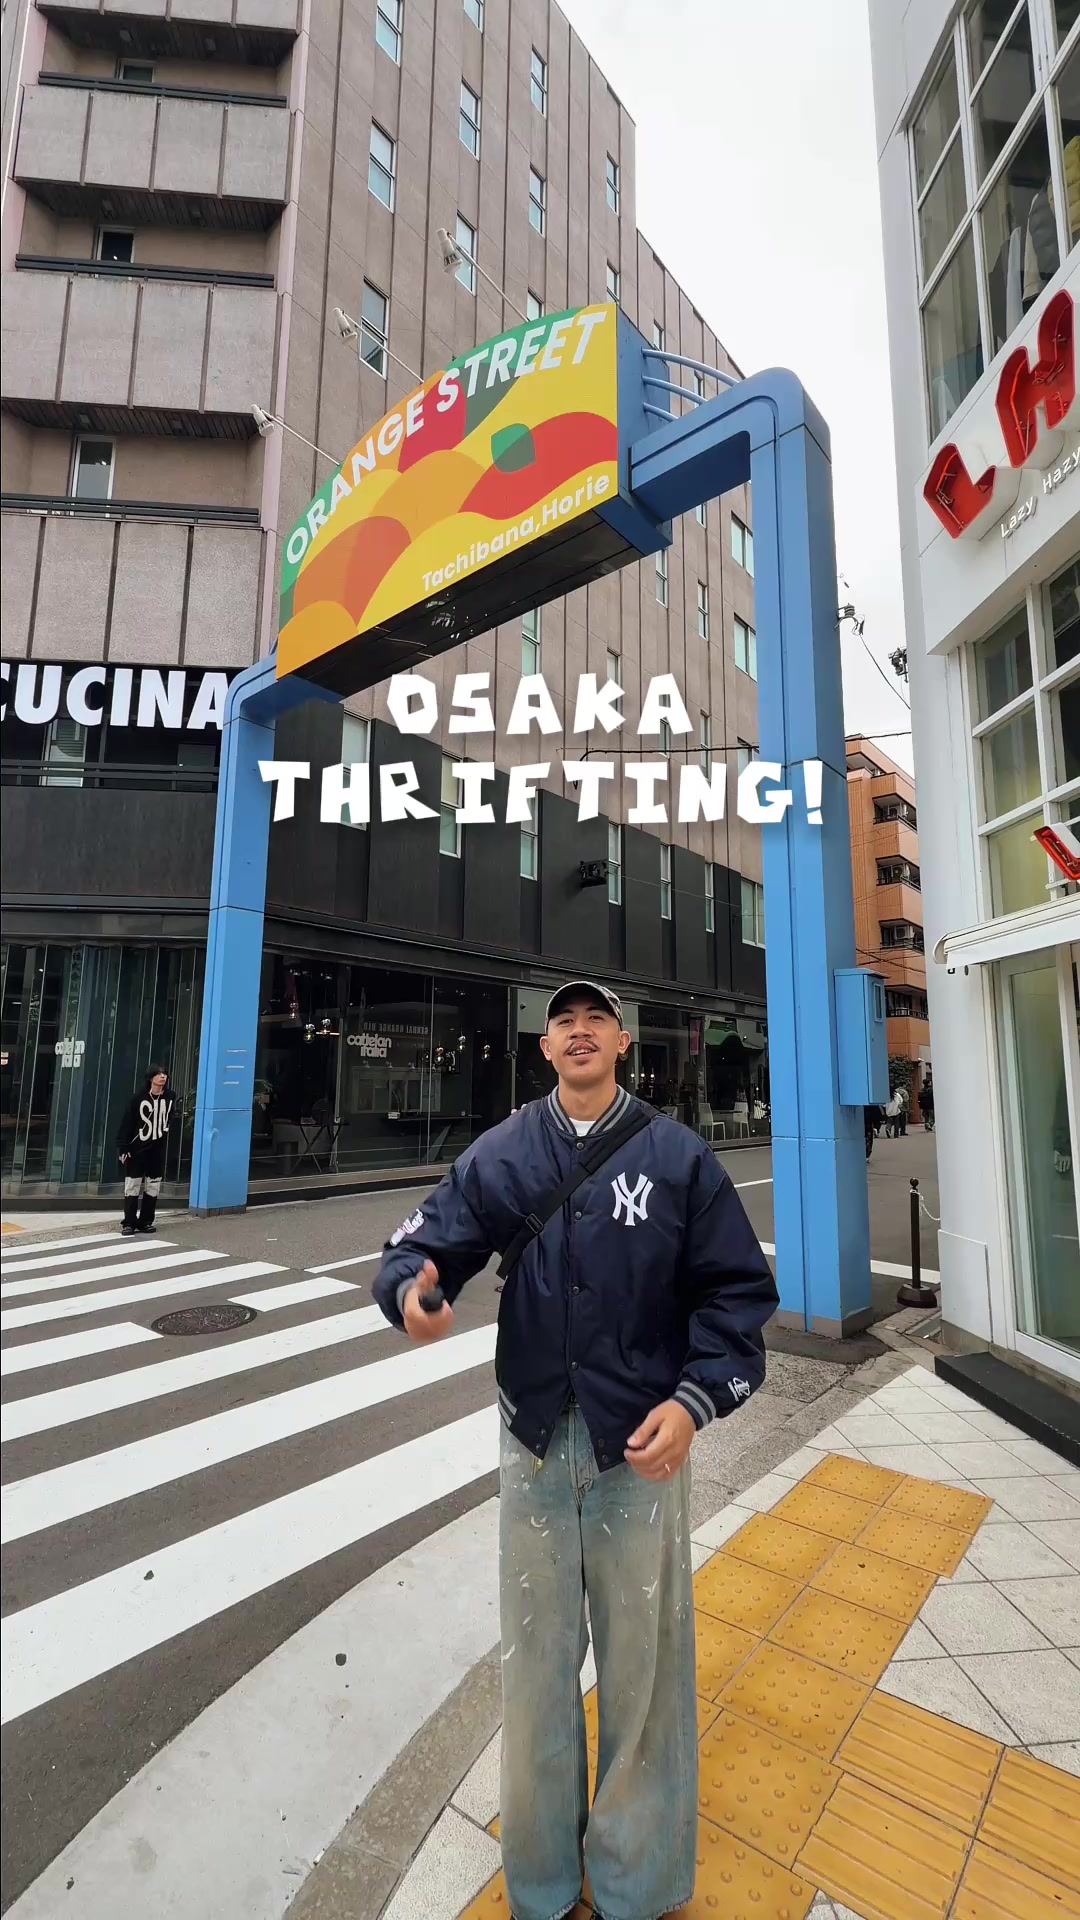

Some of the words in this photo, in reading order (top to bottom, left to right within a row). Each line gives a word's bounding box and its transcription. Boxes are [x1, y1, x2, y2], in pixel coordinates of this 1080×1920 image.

[286, 389, 425, 566] ORANGE
[436, 311, 607, 413] STREET
[1000, 495, 1034, 539] Lazy
[1042, 446, 1080, 495] Hazy
[1, 662, 229, 731] UCINA
[610, 1172, 655, 1227] NY
